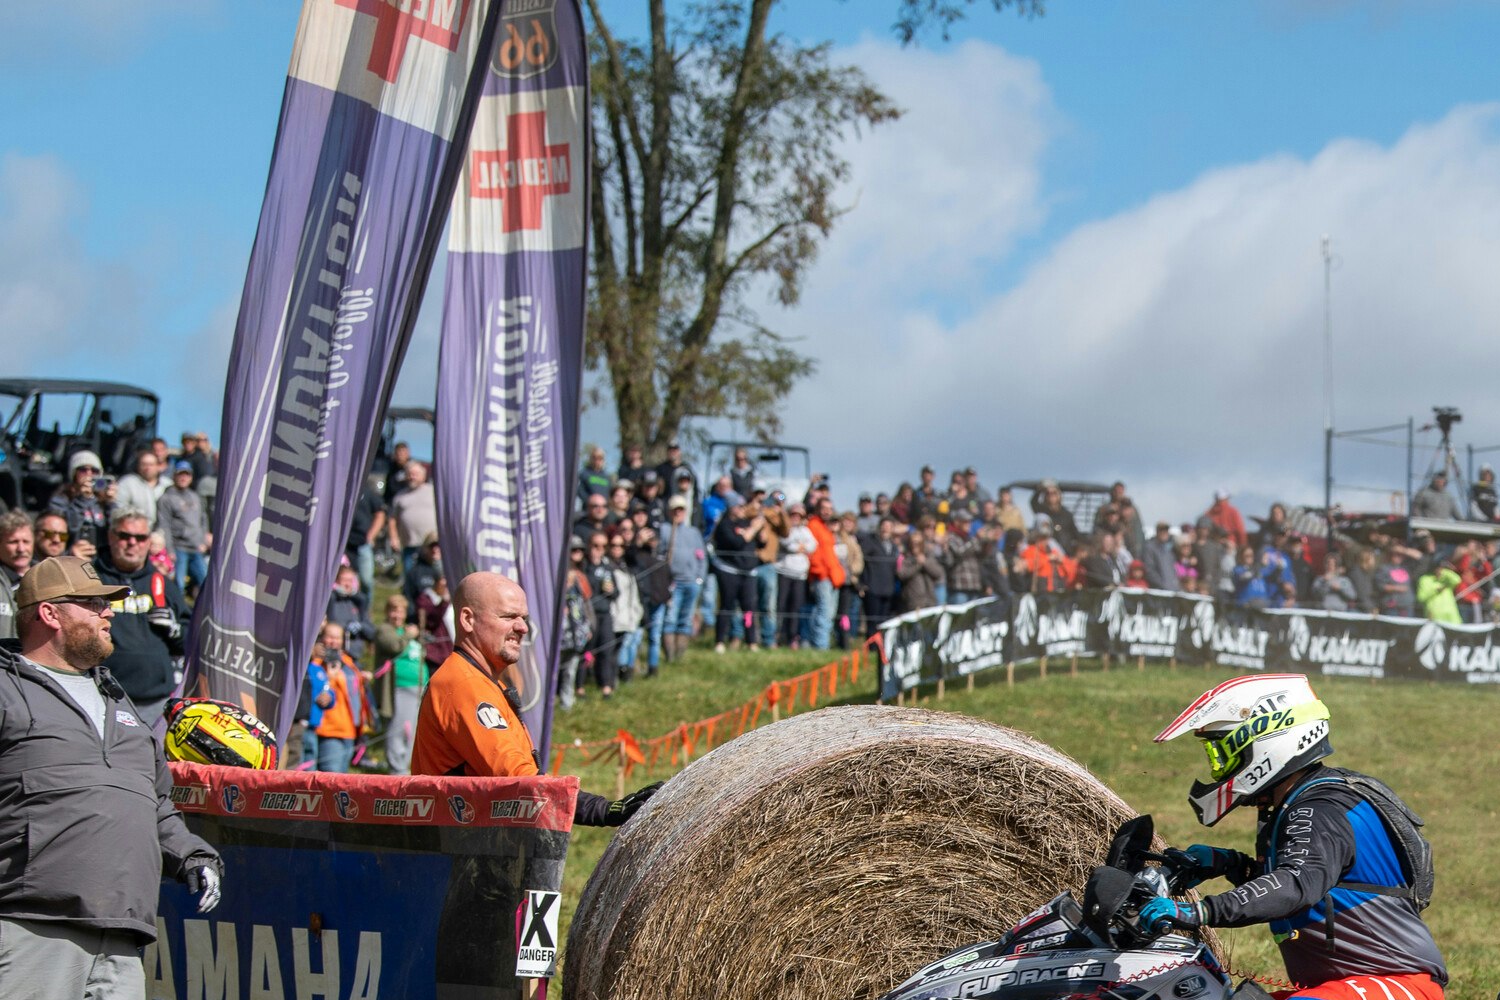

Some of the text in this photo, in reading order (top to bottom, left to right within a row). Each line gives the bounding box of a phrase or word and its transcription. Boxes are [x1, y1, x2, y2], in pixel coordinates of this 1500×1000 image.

[1224, 708, 1295, 756] 100%
[1245, 757, 1273, 786] 327
[1230, 871, 1283, 907] FLY
[521, 892, 560, 949] X
[519, 948, 555, 963] DANGER
[1030, 933, 1068, 949] FASST
[1019, 962, 1106, 986] RACING
